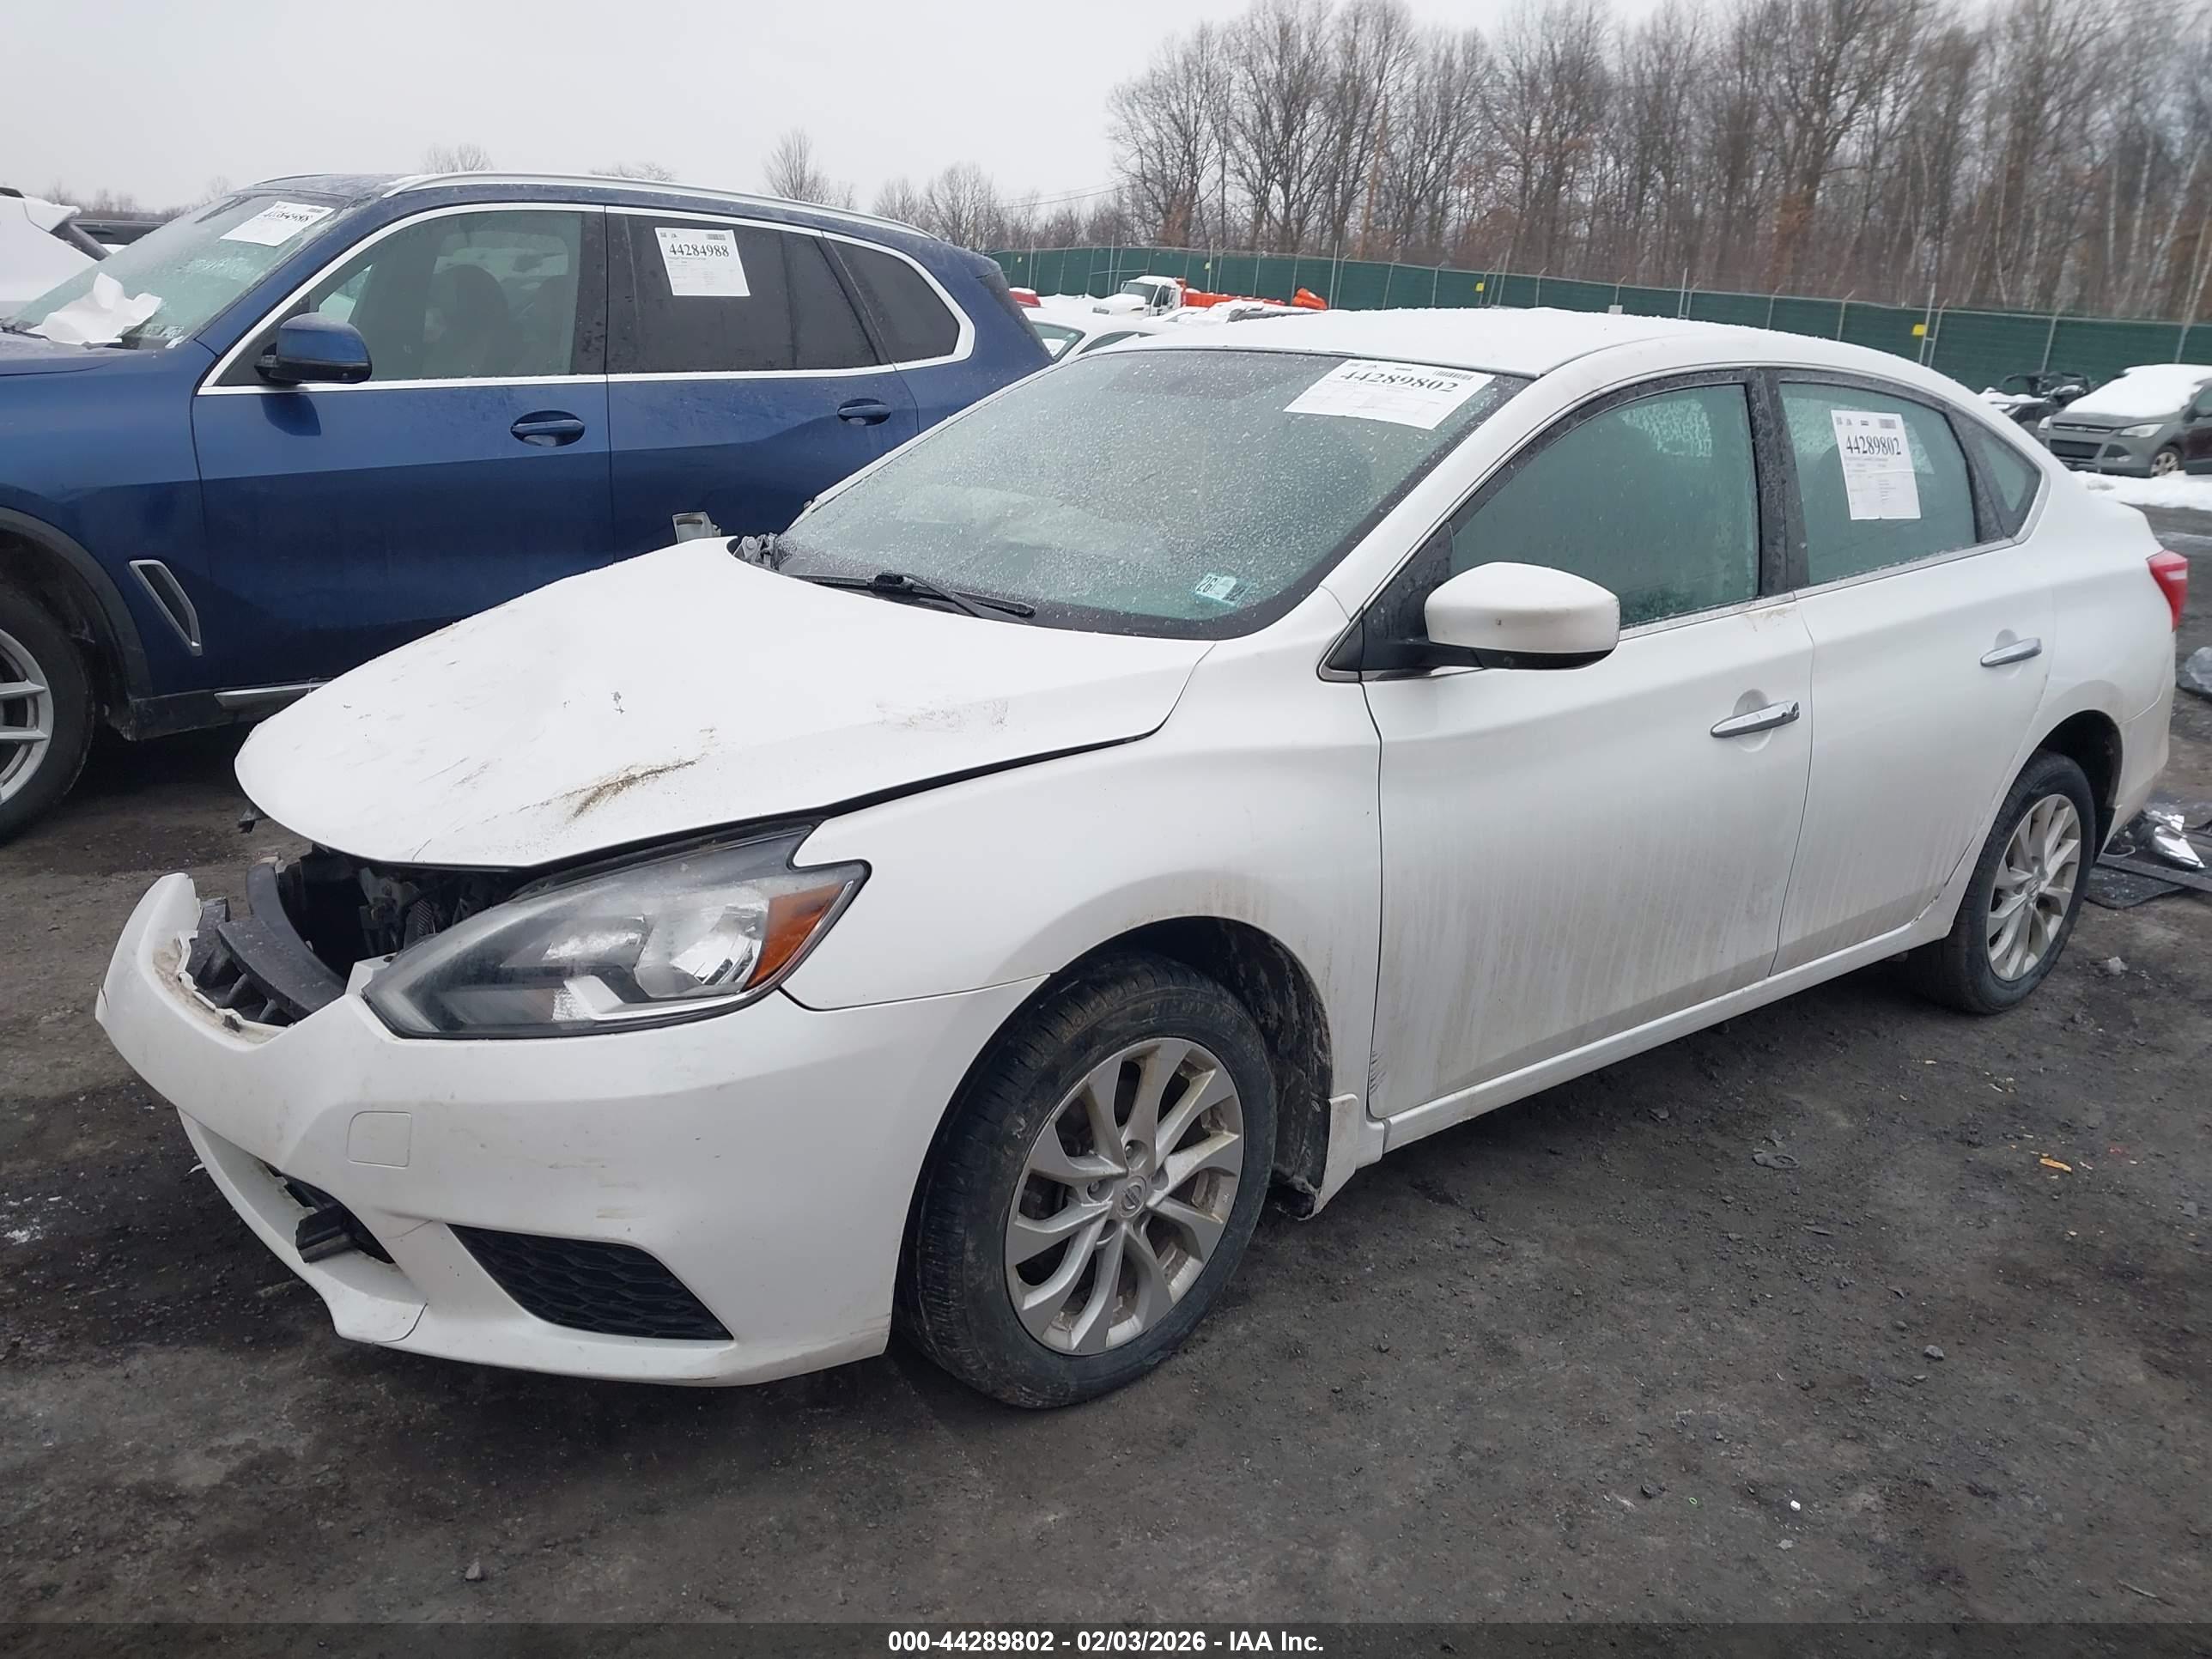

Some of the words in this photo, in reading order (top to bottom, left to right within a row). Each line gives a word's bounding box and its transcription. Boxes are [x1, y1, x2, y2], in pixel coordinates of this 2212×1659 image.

[669, 243, 730, 258] 44284988
[1340, 369, 1459, 392] 44289802
[1845, 434, 1902, 456] 44289802
